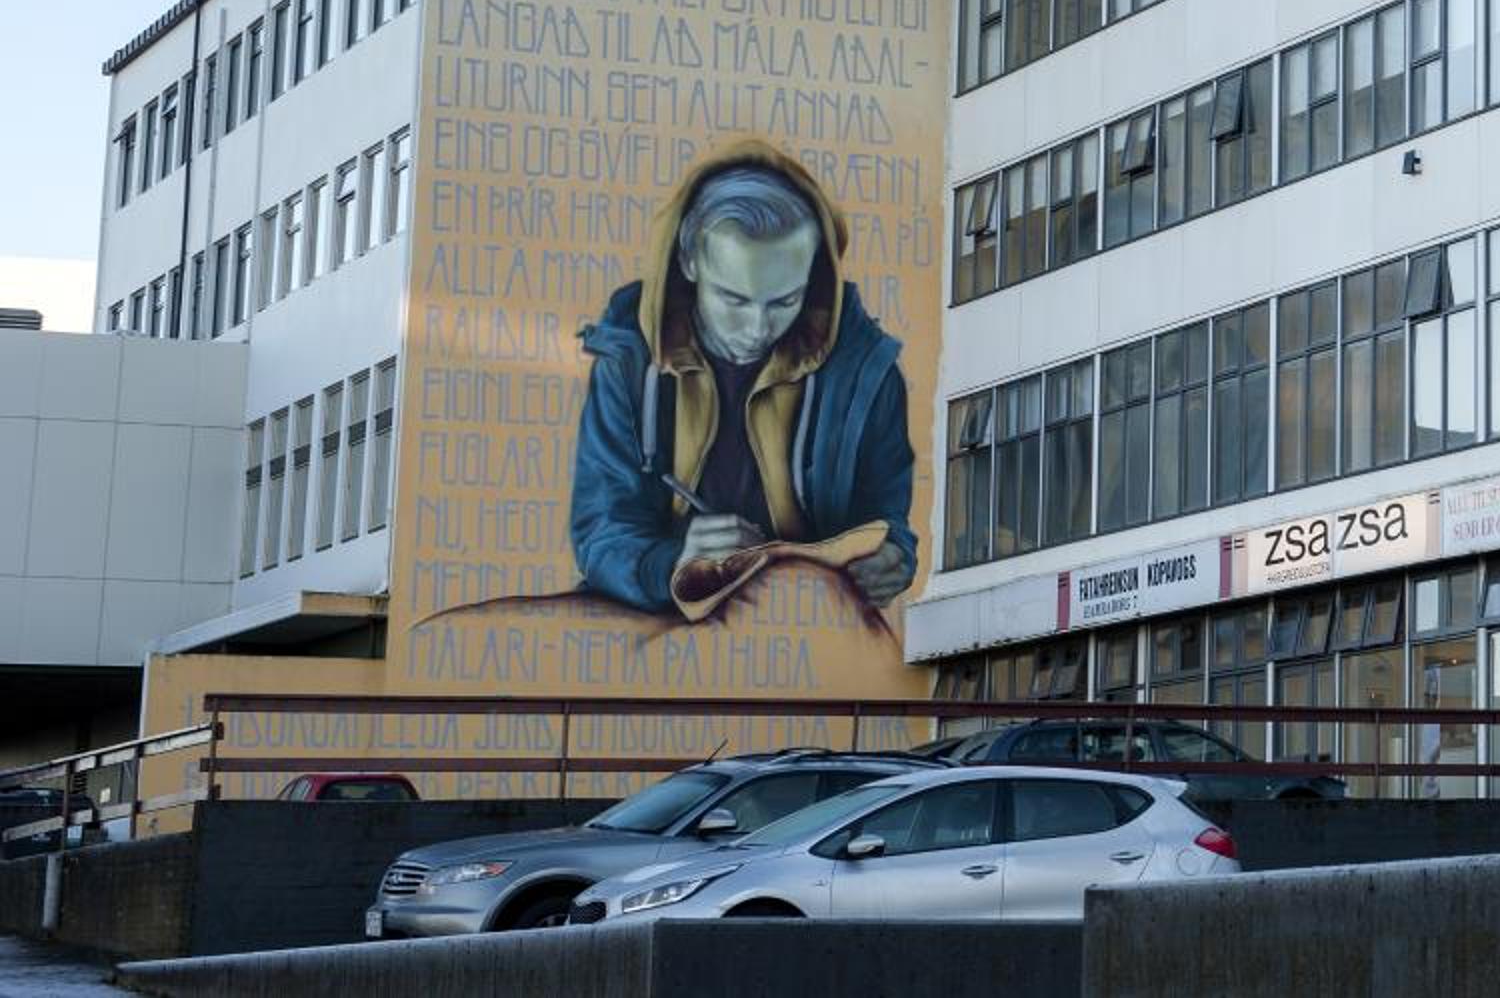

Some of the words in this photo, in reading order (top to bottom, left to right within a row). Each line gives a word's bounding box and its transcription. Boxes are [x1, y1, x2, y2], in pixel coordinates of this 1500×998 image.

[596, 10, 640, 62] TIL
[651, 15, 703, 69] AÐ
[607, 70, 678, 126] SEM
[687, 80, 764, 134] ALLT
[768, 88, 894, 146] ANNAÐ
[433, 118, 511, 173] EINS
[523, 125, 571, 178] OG
[432, 180, 478, 235] EN
[424, 242, 501, 298] ALLT
[1265, 519, 1331, 566] zsa
[1336, 503, 1408, 550] zsa
